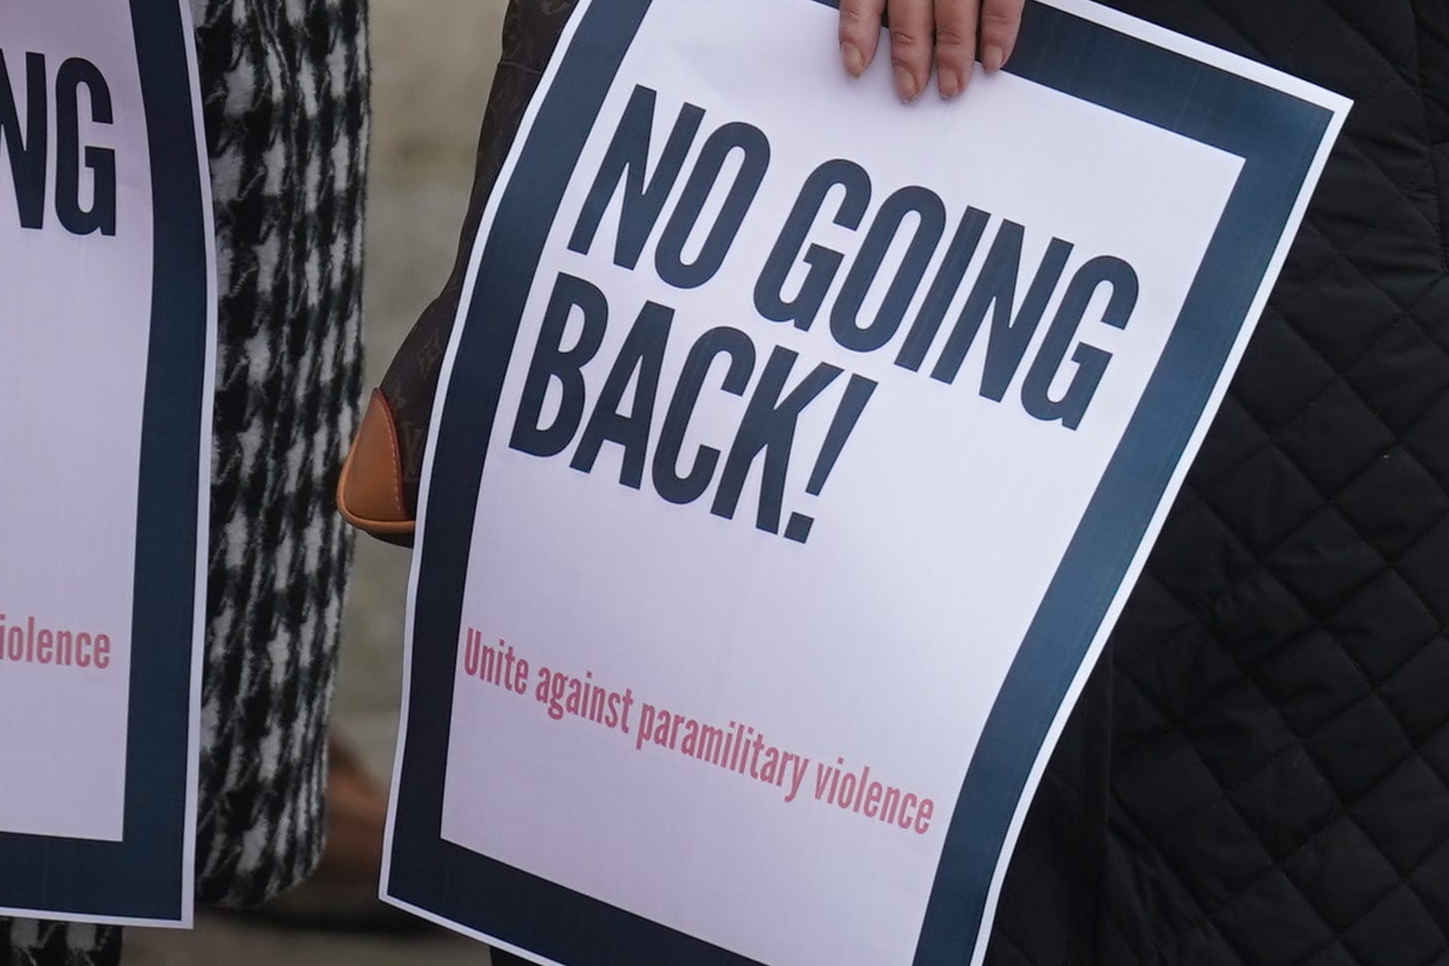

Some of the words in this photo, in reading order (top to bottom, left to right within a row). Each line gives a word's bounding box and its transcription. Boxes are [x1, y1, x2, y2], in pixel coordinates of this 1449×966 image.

[566, 83, 771, 289] NO
[753, 158, 1139, 431] GOING
[508, 271, 879, 545] BACK!
[464, 627, 529, 694] Unite
[535, 666, 634, 734] against
[636, 702, 810, 804] paramilitary
[814, 758, 935, 836] violence
